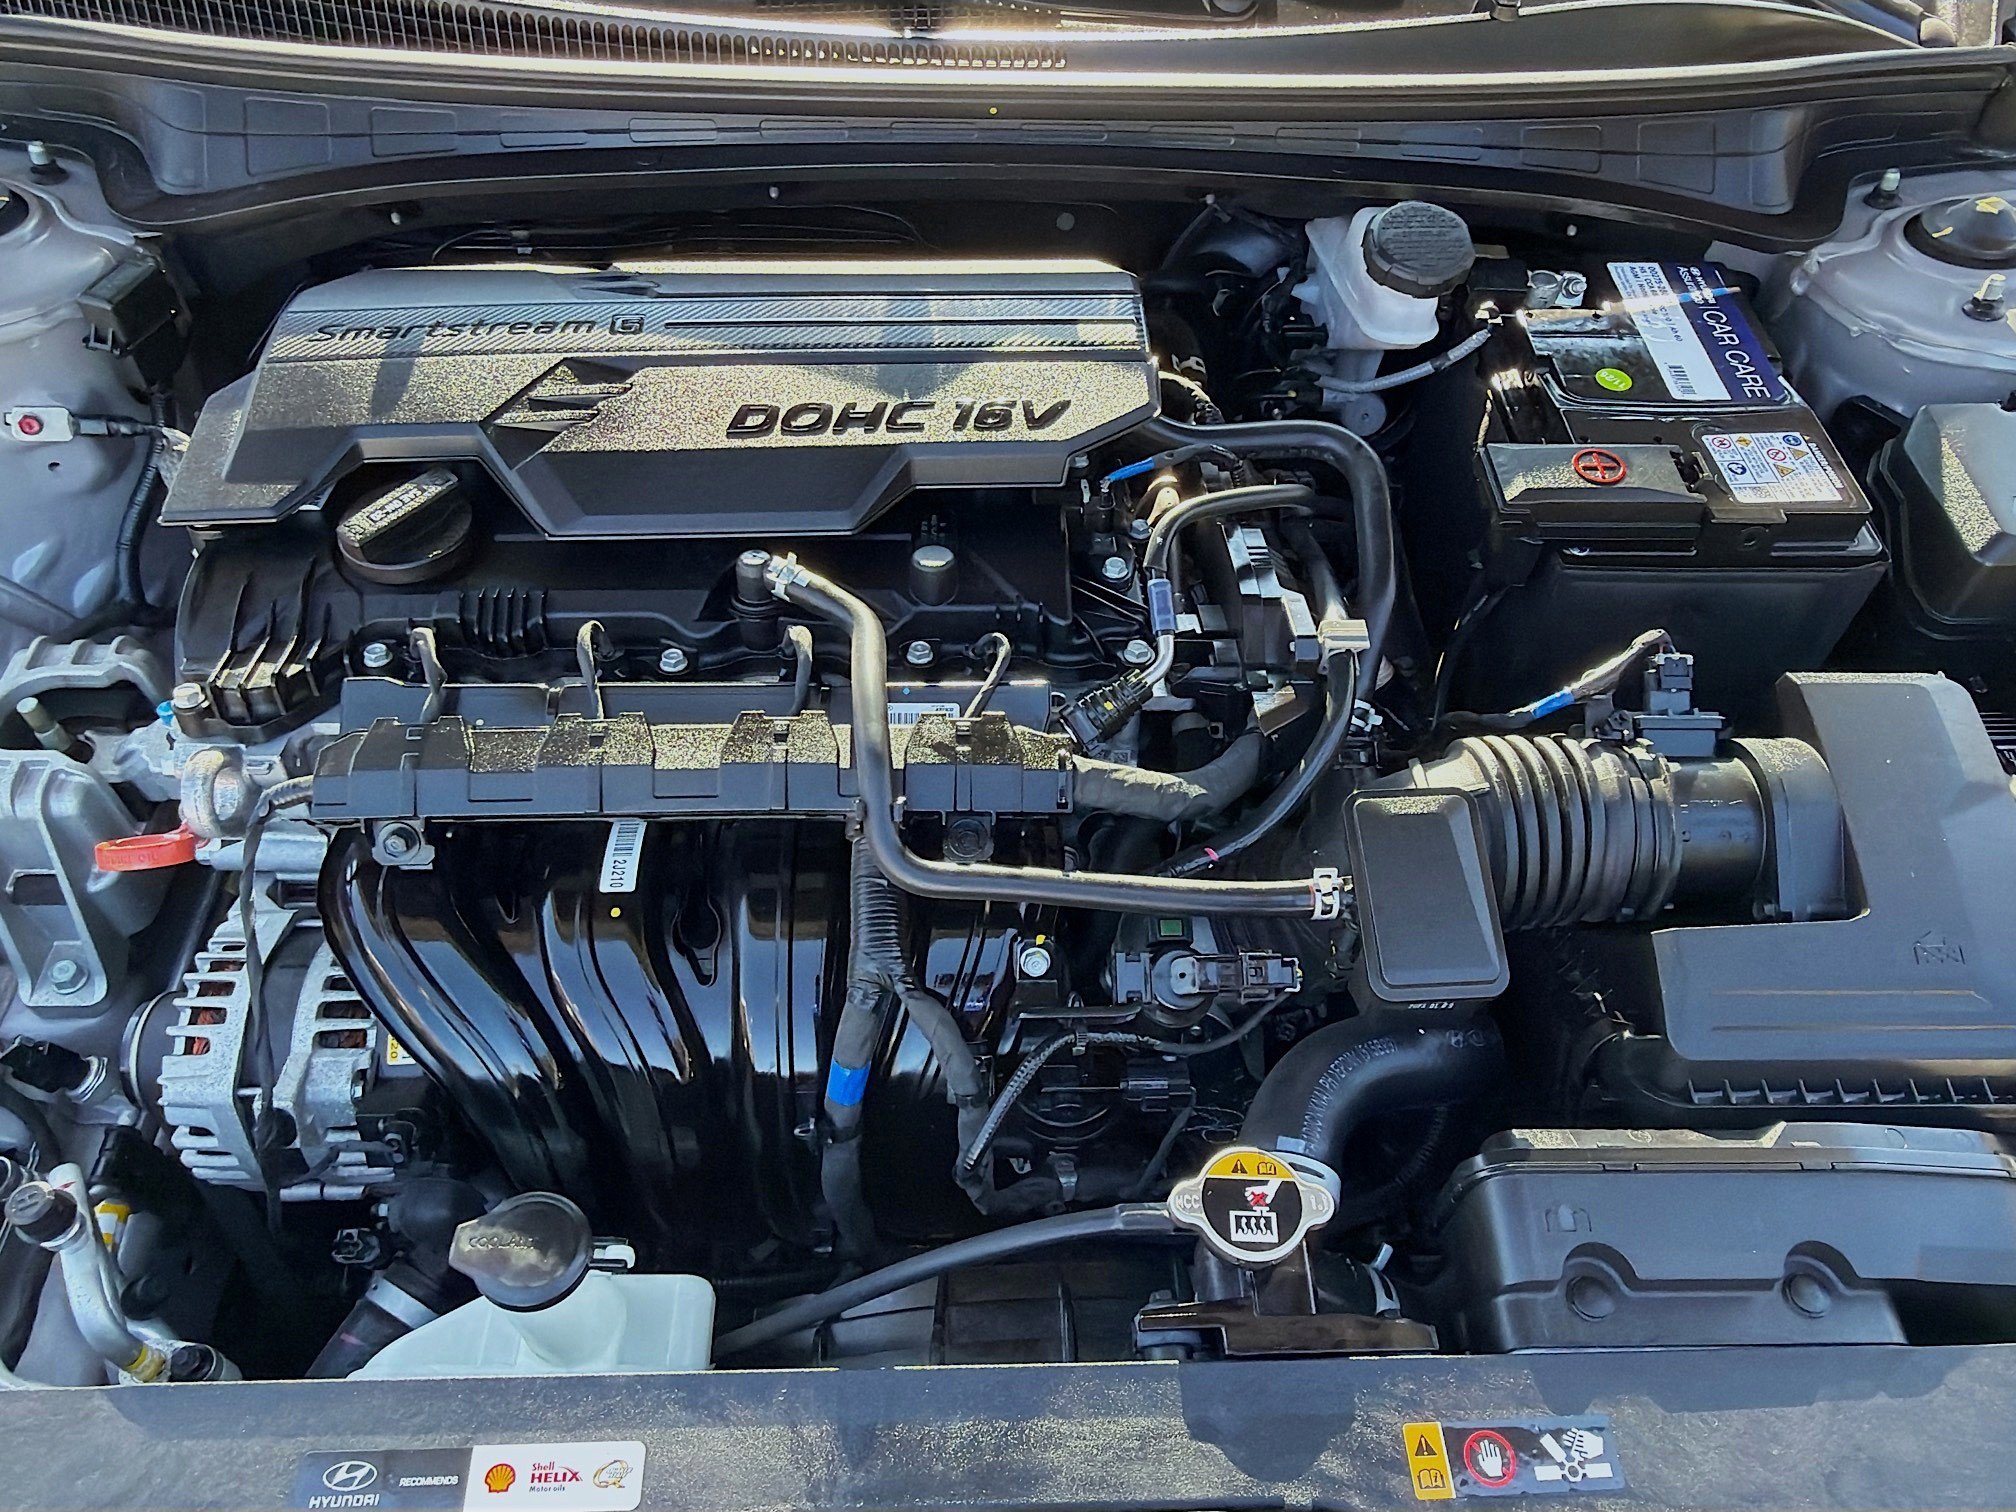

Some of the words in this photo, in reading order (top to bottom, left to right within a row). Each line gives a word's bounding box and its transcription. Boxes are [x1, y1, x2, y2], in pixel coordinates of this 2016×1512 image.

[308, 319, 597, 343] Smartstream
[1702, 311, 1740, 346] CAR
[1725, 350, 1772, 399] CARE
[726, 399, 937, 439] DOHC
[951, 398, 1073, 432] 16V
[609, 859, 628, 889] 2J210
[532, 1461, 556, 1472] Shell
[398, 1474, 460, 1487] RECOMMENDS
[530, 1471, 586, 1486] HELIX
[529, 1486, 552, 1494] Motor
[554, 1484, 567, 1493] oils
[308, 1493, 380, 1510] HYUNDAI
